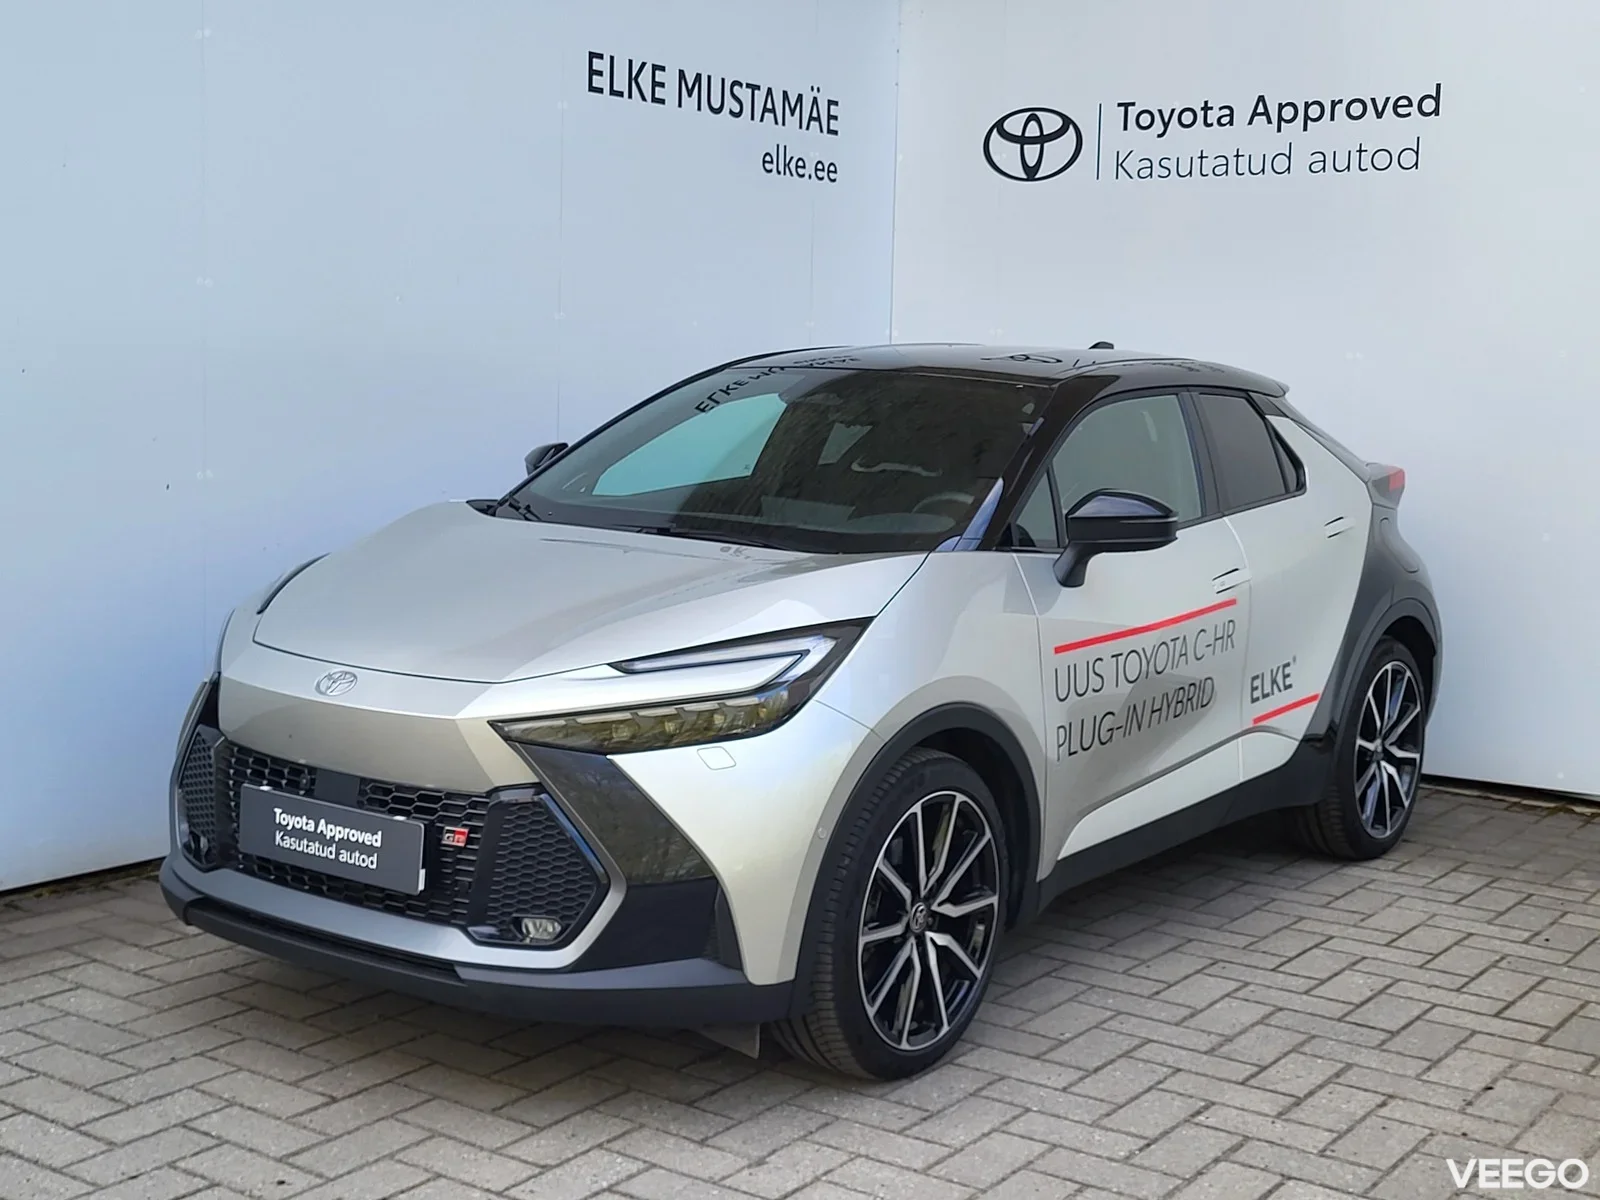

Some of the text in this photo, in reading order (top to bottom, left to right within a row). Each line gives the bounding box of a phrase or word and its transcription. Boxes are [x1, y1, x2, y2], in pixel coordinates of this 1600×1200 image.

[587, 50, 839, 136] ELKE MUSTAMÄE
[1117, 82, 1442, 138] Toyota Approved
[762, 143, 838, 183] elke.ee
[1115, 136, 1421, 181] Kasutatud autod
[1054, 618, 1236, 703] UUS TOYOTA C-HR
[1056, 676, 1215, 762] PLUG-IN HYBRID
[273, 807, 382, 848] Toyota Approved
[275, 830, 378, 870] Kasutatud autod
